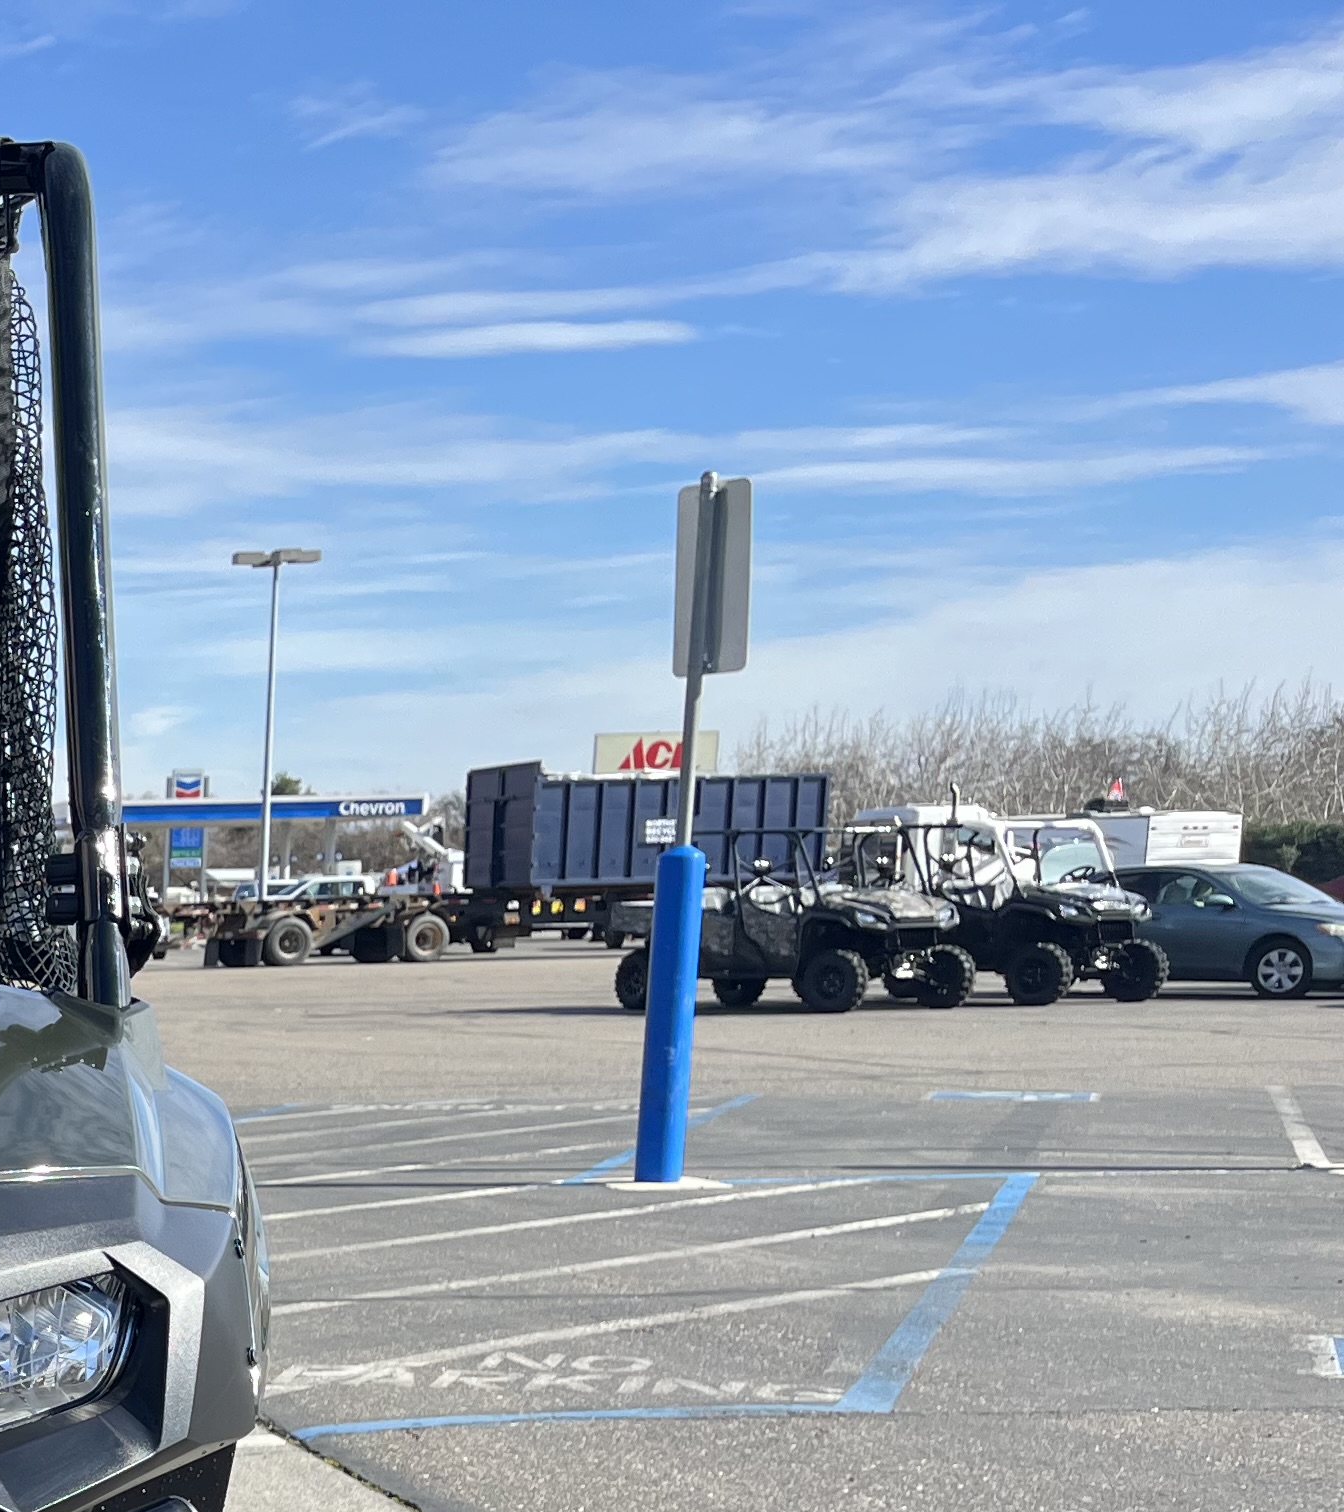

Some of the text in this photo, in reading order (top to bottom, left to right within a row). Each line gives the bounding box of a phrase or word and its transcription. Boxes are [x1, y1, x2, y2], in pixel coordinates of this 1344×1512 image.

[339, 802, 405, 816] Chevron
[479, 1352, 654, 1373] NO
[267, 1363, 848, 1401] PARKING
